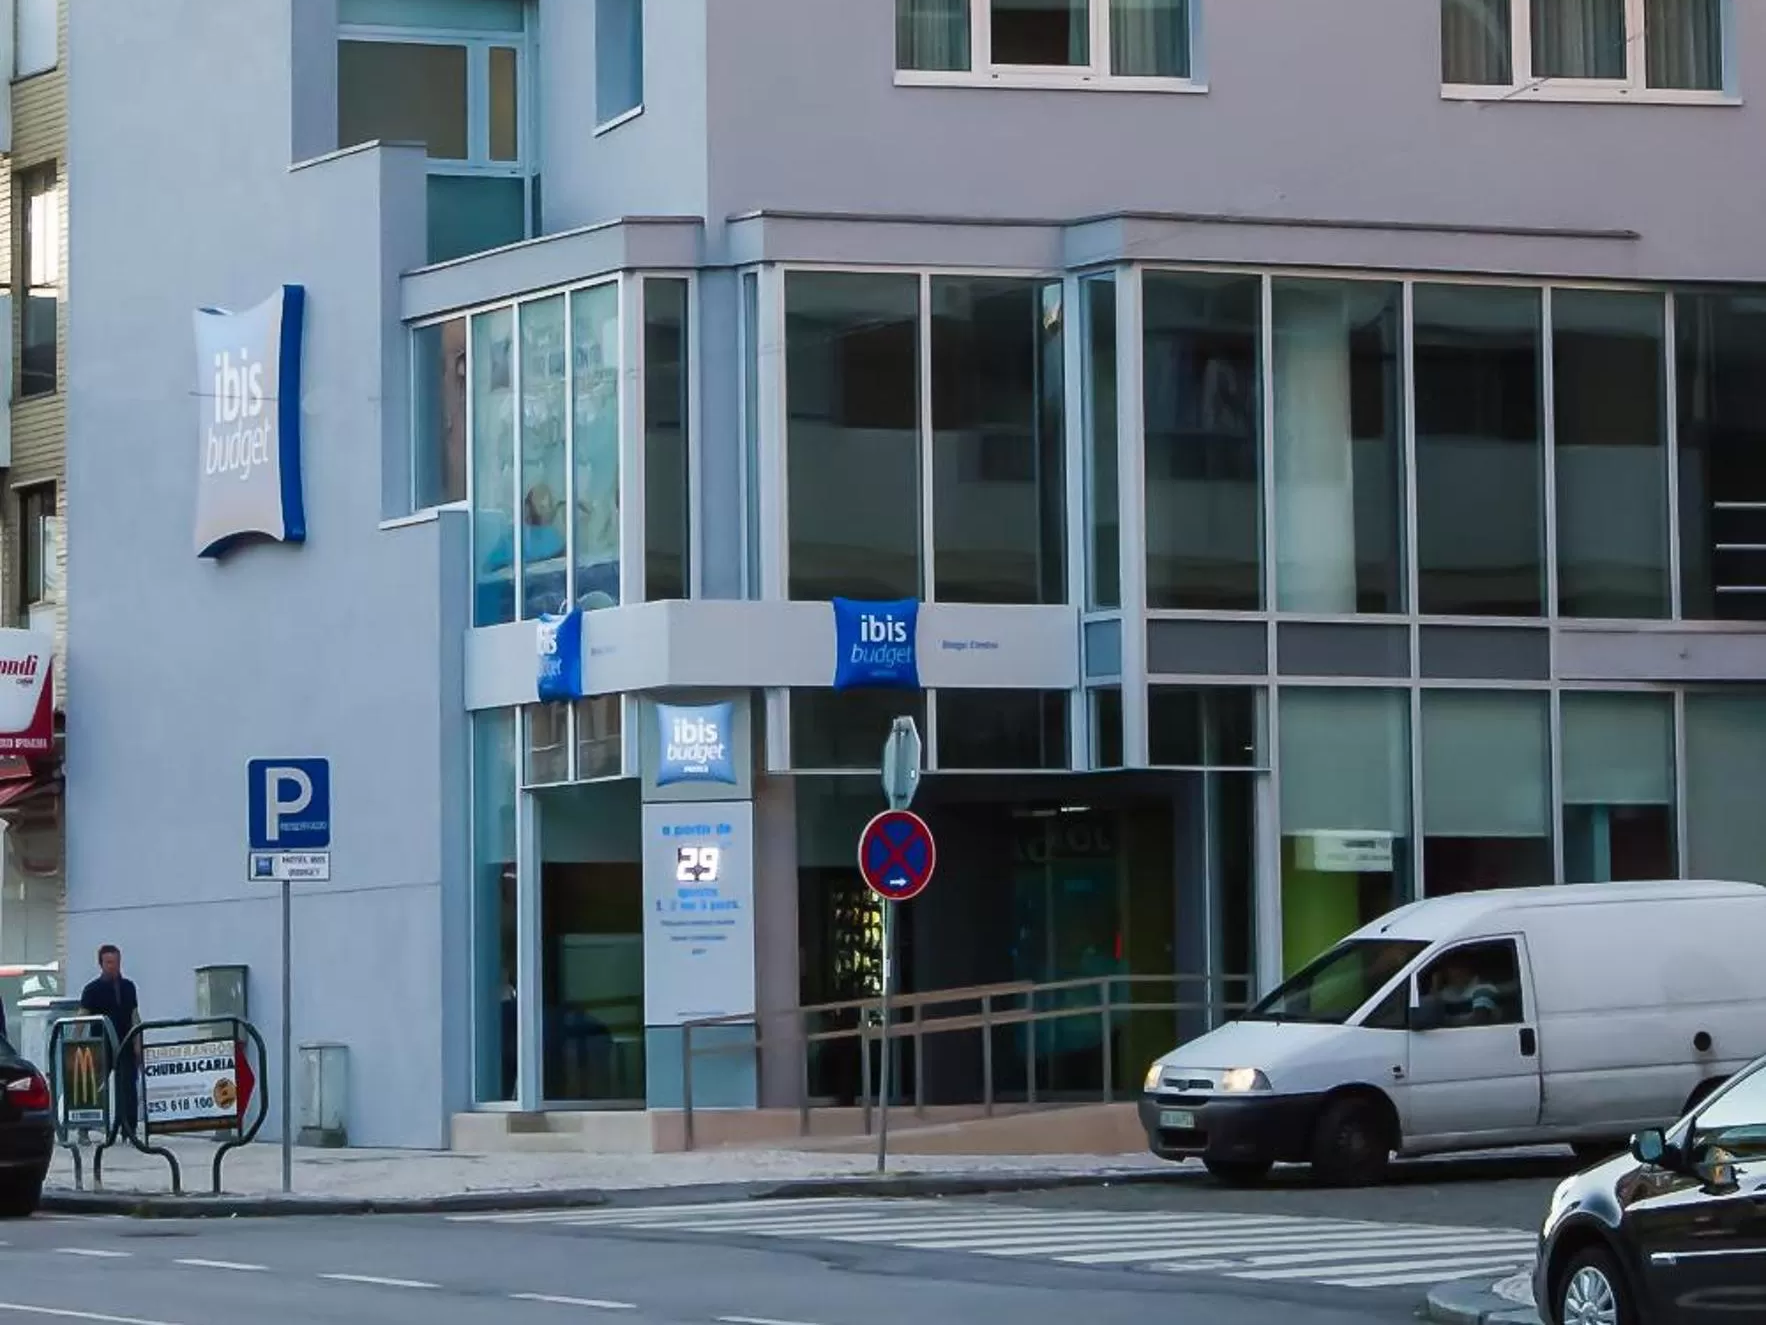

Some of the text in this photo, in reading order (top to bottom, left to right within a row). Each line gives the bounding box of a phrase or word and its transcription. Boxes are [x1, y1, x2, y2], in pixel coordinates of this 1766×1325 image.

[213, 347, 264, 424] ibis
[205, 419, 271, 481] budget
[860, 613, 907, 643] ibis
[851, 643, 912, 669] budget
[673, 716, 718, 744] ibis
[666, 742, 726, 764] budget
[265, 767, 313, 841] P
[676, 846, 719, 882] 29
